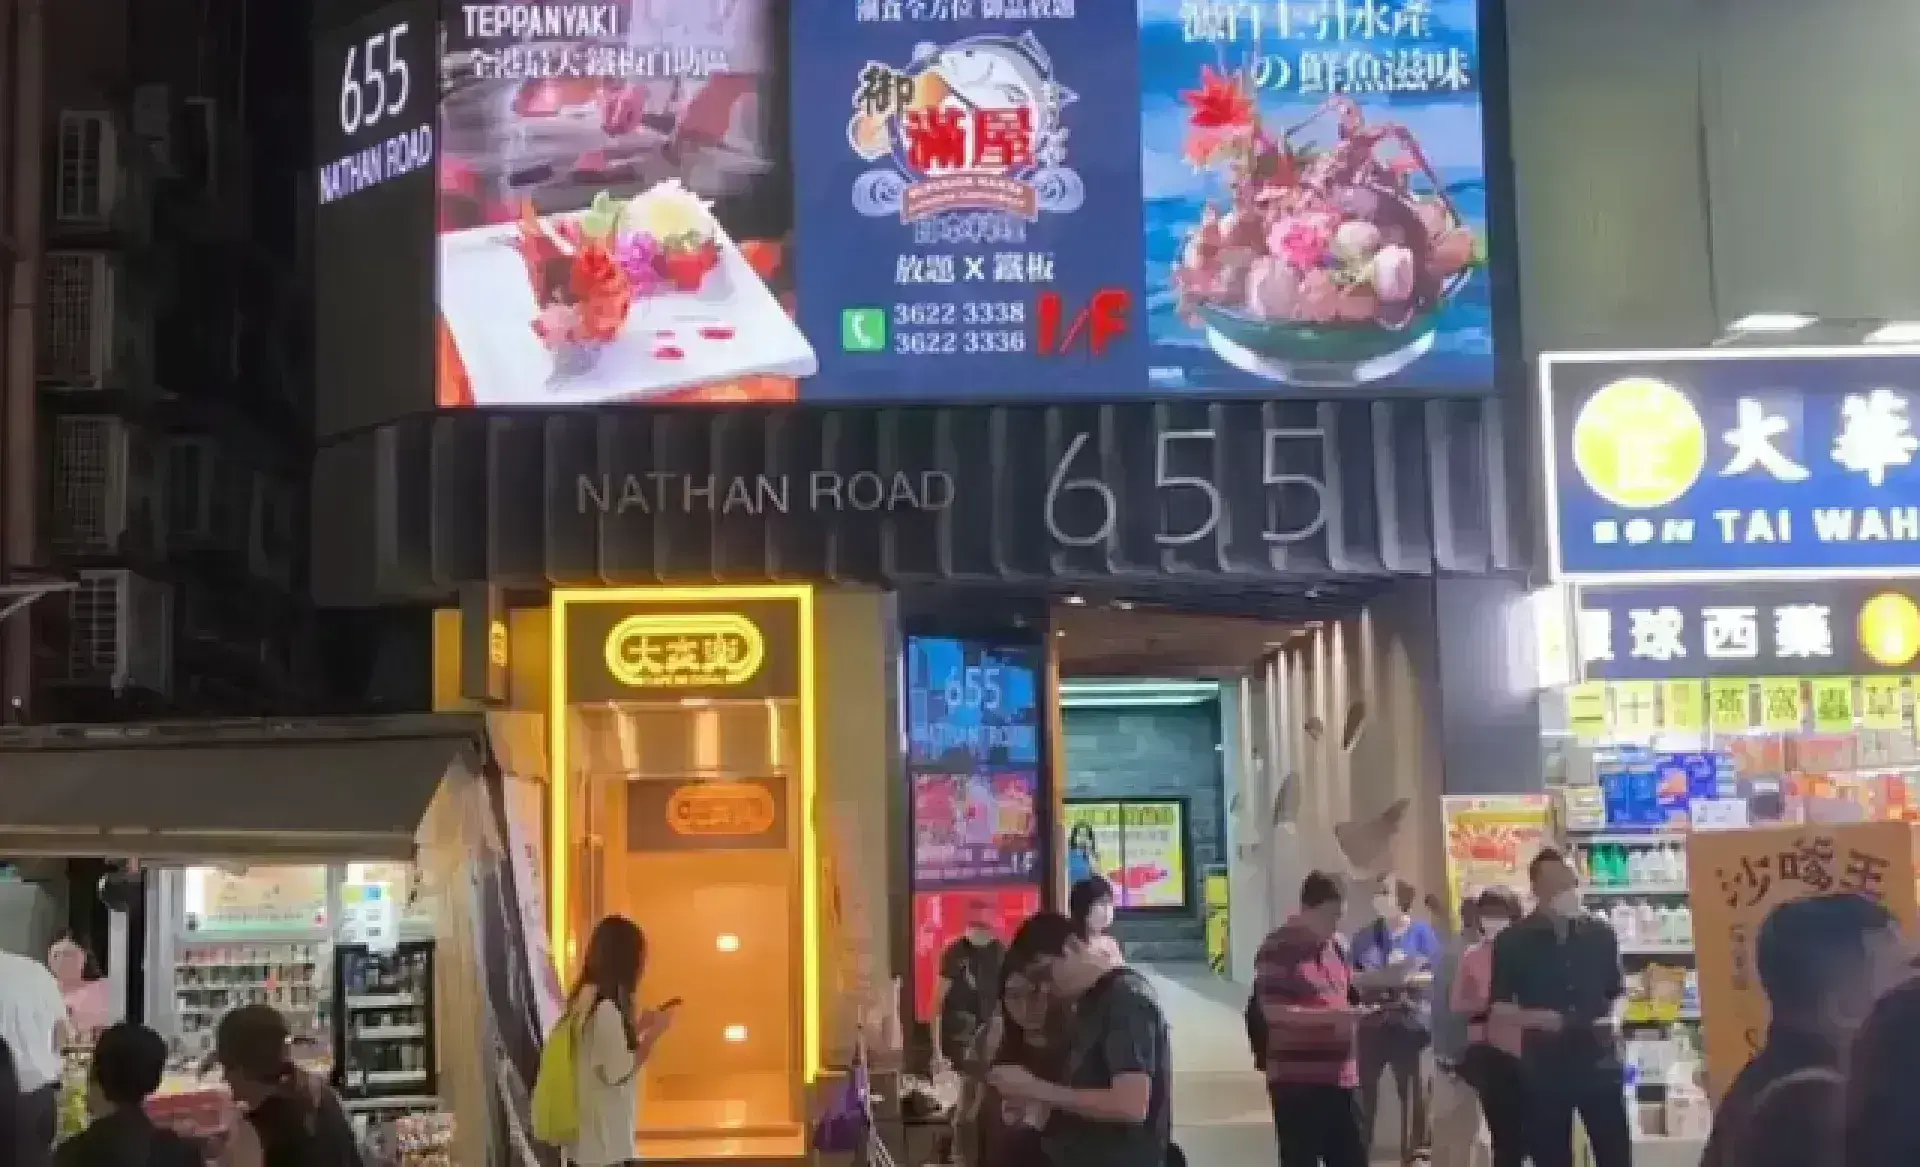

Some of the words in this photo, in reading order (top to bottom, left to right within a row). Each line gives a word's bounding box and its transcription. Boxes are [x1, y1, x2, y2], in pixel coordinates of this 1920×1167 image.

[462, 4, 619, 37] TEPPANYAKI
[340, 21, 408, 135] 655
[1251, 54, 1291, 90] の
[319, 143, 382, 204] NATHAN
[385, 123, 433, 180] ROAD
[894, 301, 954, 326] 3622
[962, 301, 1025, 325] 3338
[894, 330, 955, 354] 3622
[962, 330, 1027, 353] 3336
[576, 470, 790, 515] NATHAN
[809, 470, 956, 513] ROAD
[1044, 428, 1327, 546] 655
[1712, 507, 1792, 544] TAI
[1812, 506, 1920, 543] WAH
[945, 665, 1001, 709] 655
